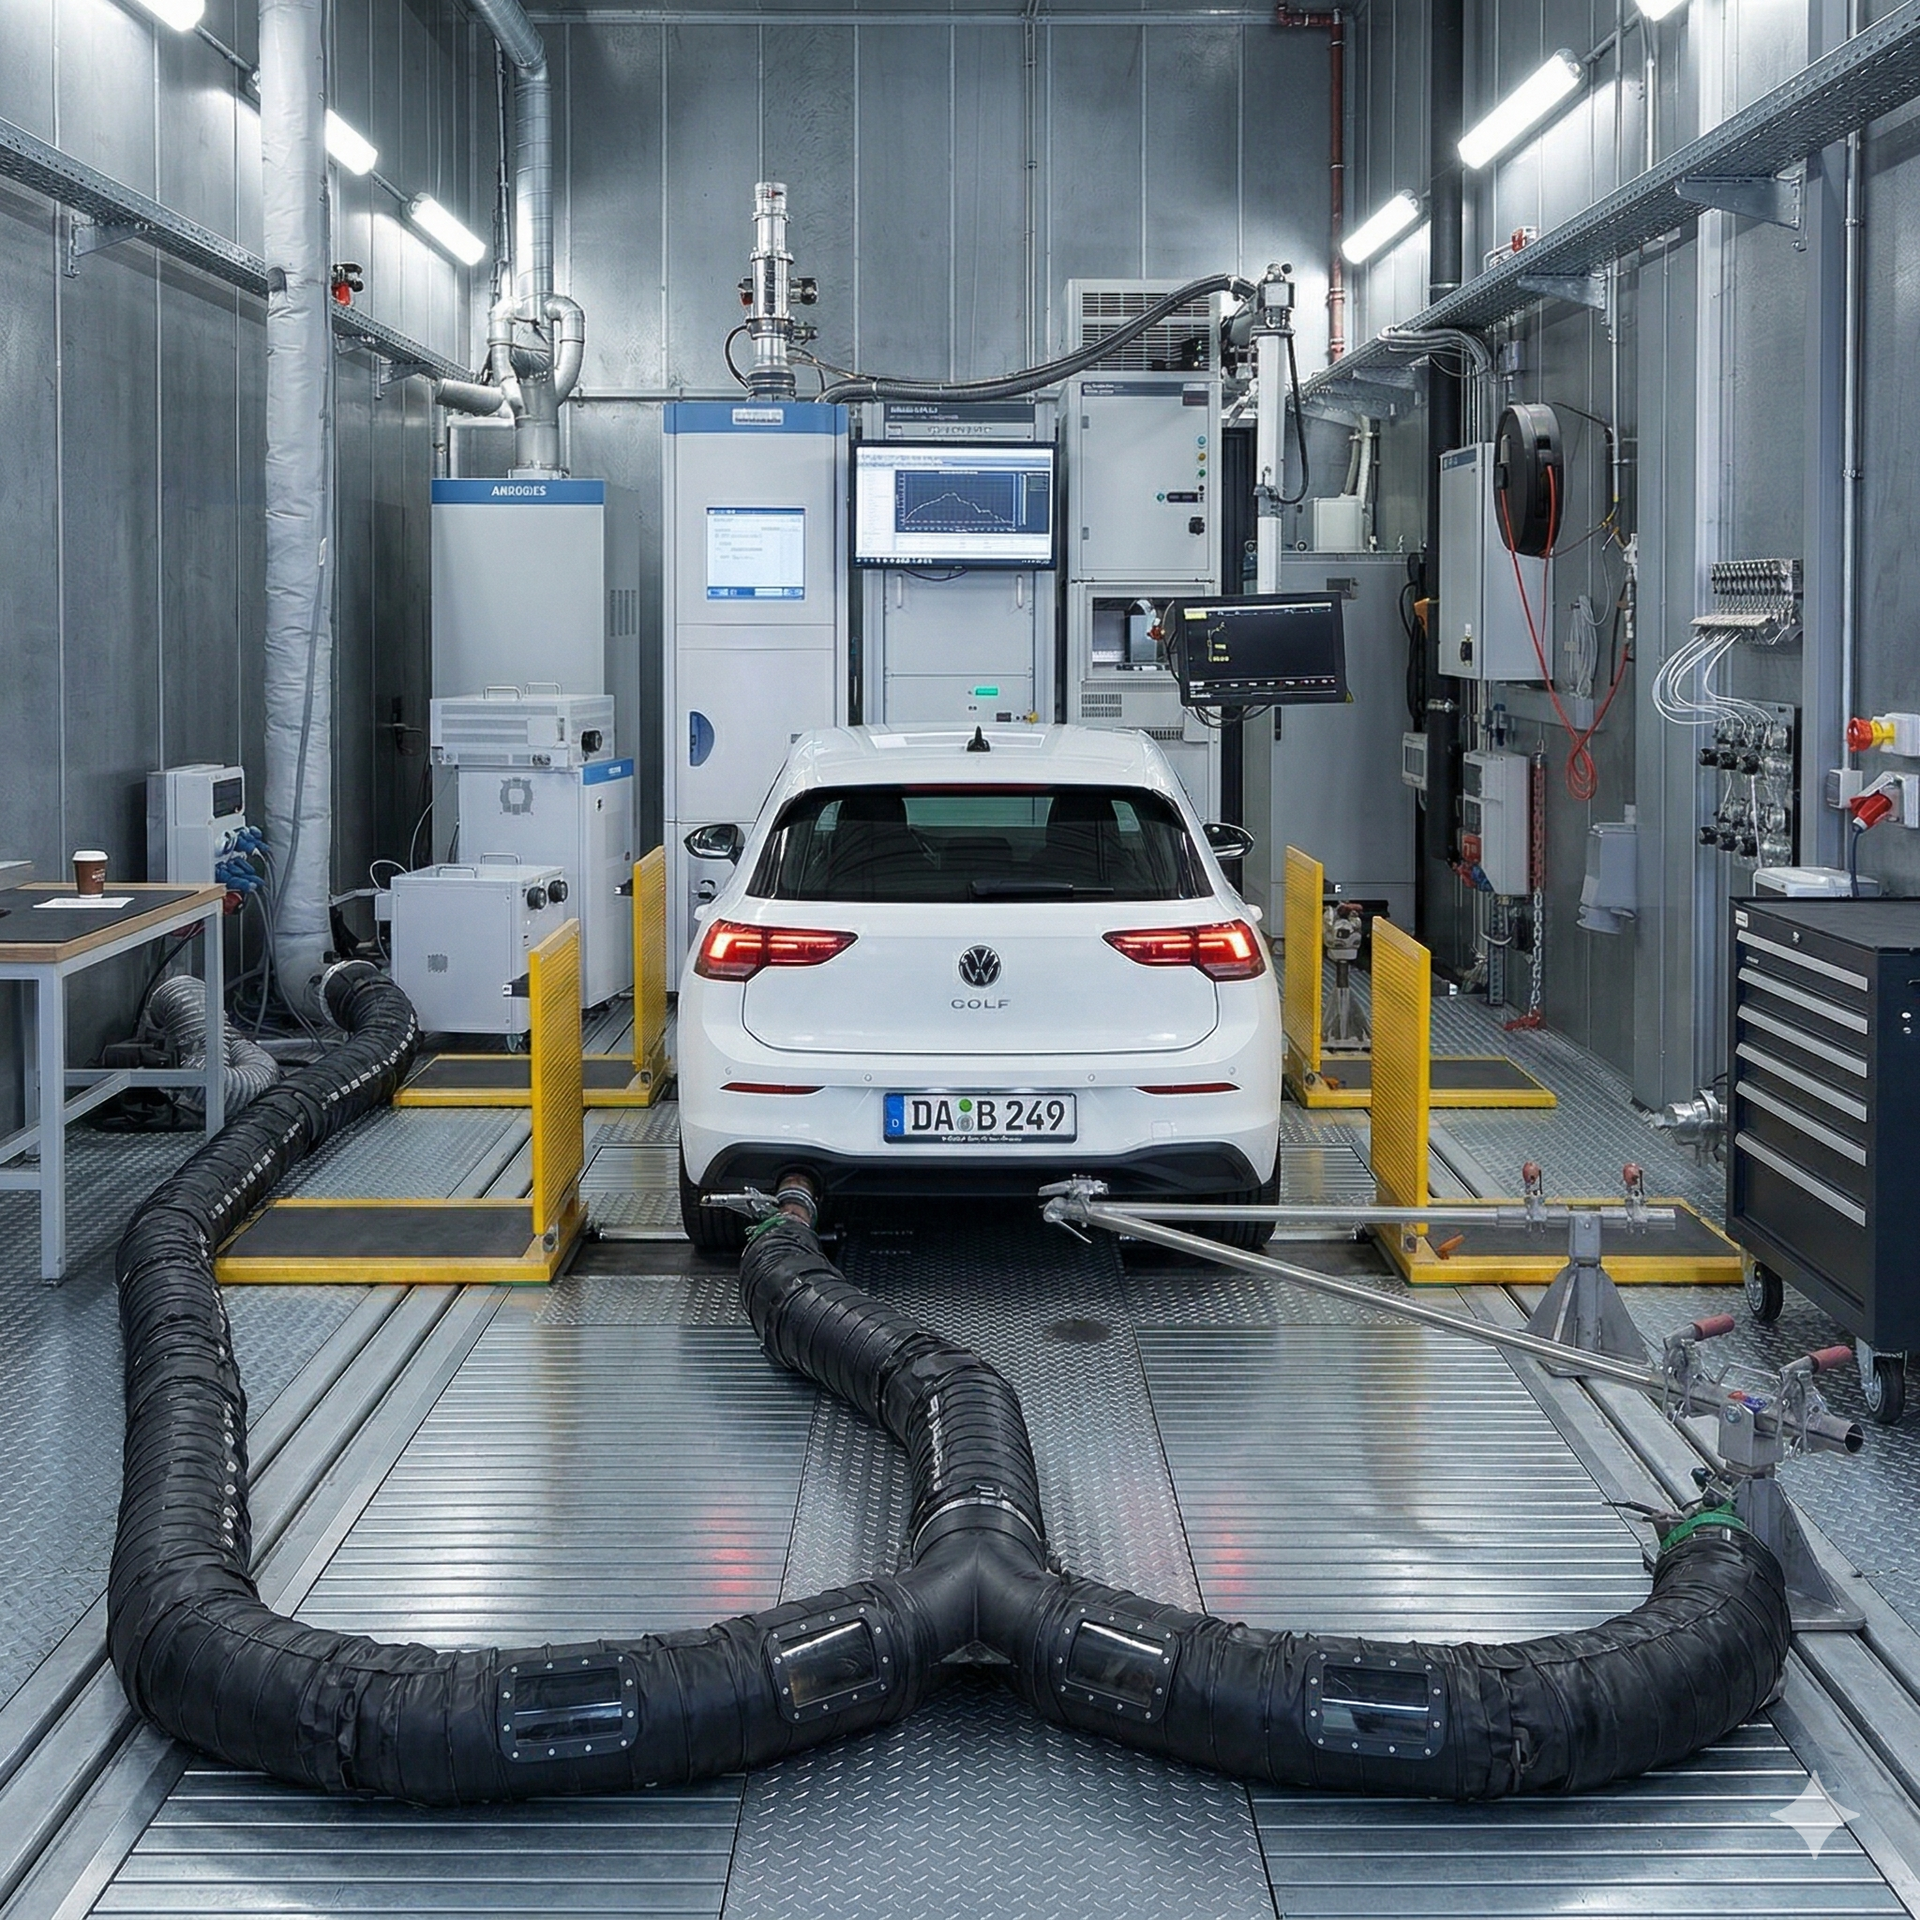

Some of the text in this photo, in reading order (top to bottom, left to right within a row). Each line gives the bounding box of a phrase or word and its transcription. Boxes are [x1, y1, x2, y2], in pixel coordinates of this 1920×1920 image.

[951, 999, 1011, 1010] GOLF
[911, 1100, 1065, 1131] DA B 249
[891, 1118, 900, 1128] D
